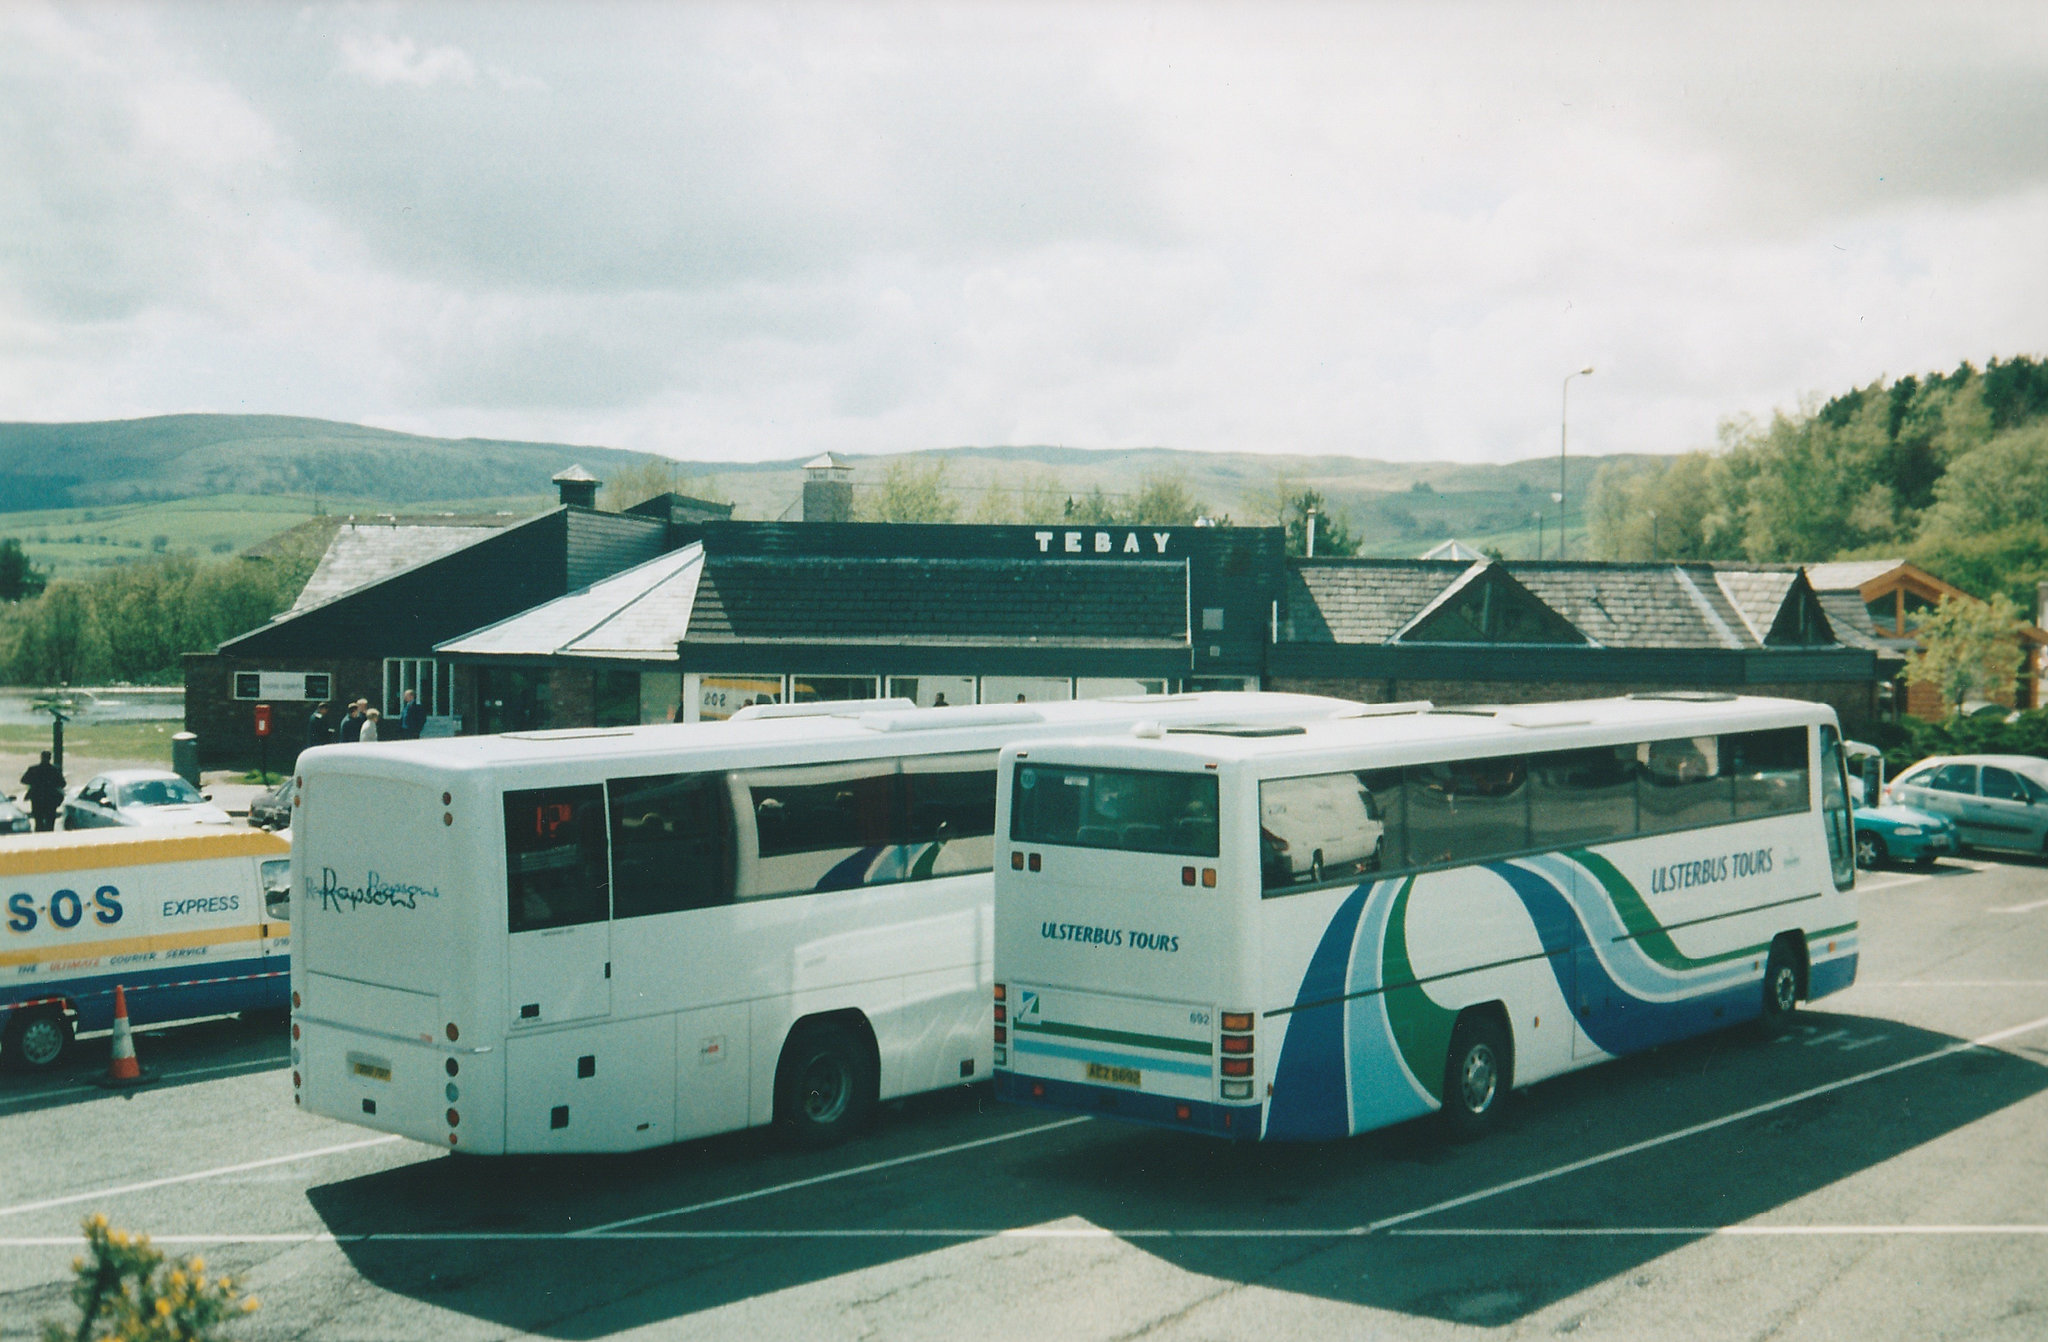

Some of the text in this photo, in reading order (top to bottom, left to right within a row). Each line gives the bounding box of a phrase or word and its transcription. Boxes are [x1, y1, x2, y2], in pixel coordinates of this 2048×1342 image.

[1035, 531, 1170, 553] TEBAY
[1652, 848, 1773, 894] ULSTERBUS TOURS
[163, 895, 239, 917] EXPRESS
[1041, 921, 1179, 952] ULSTERBUS TOURS
[109, 951, 157, 965] COURIER
[165, 946, 208, 959] SERVICE
